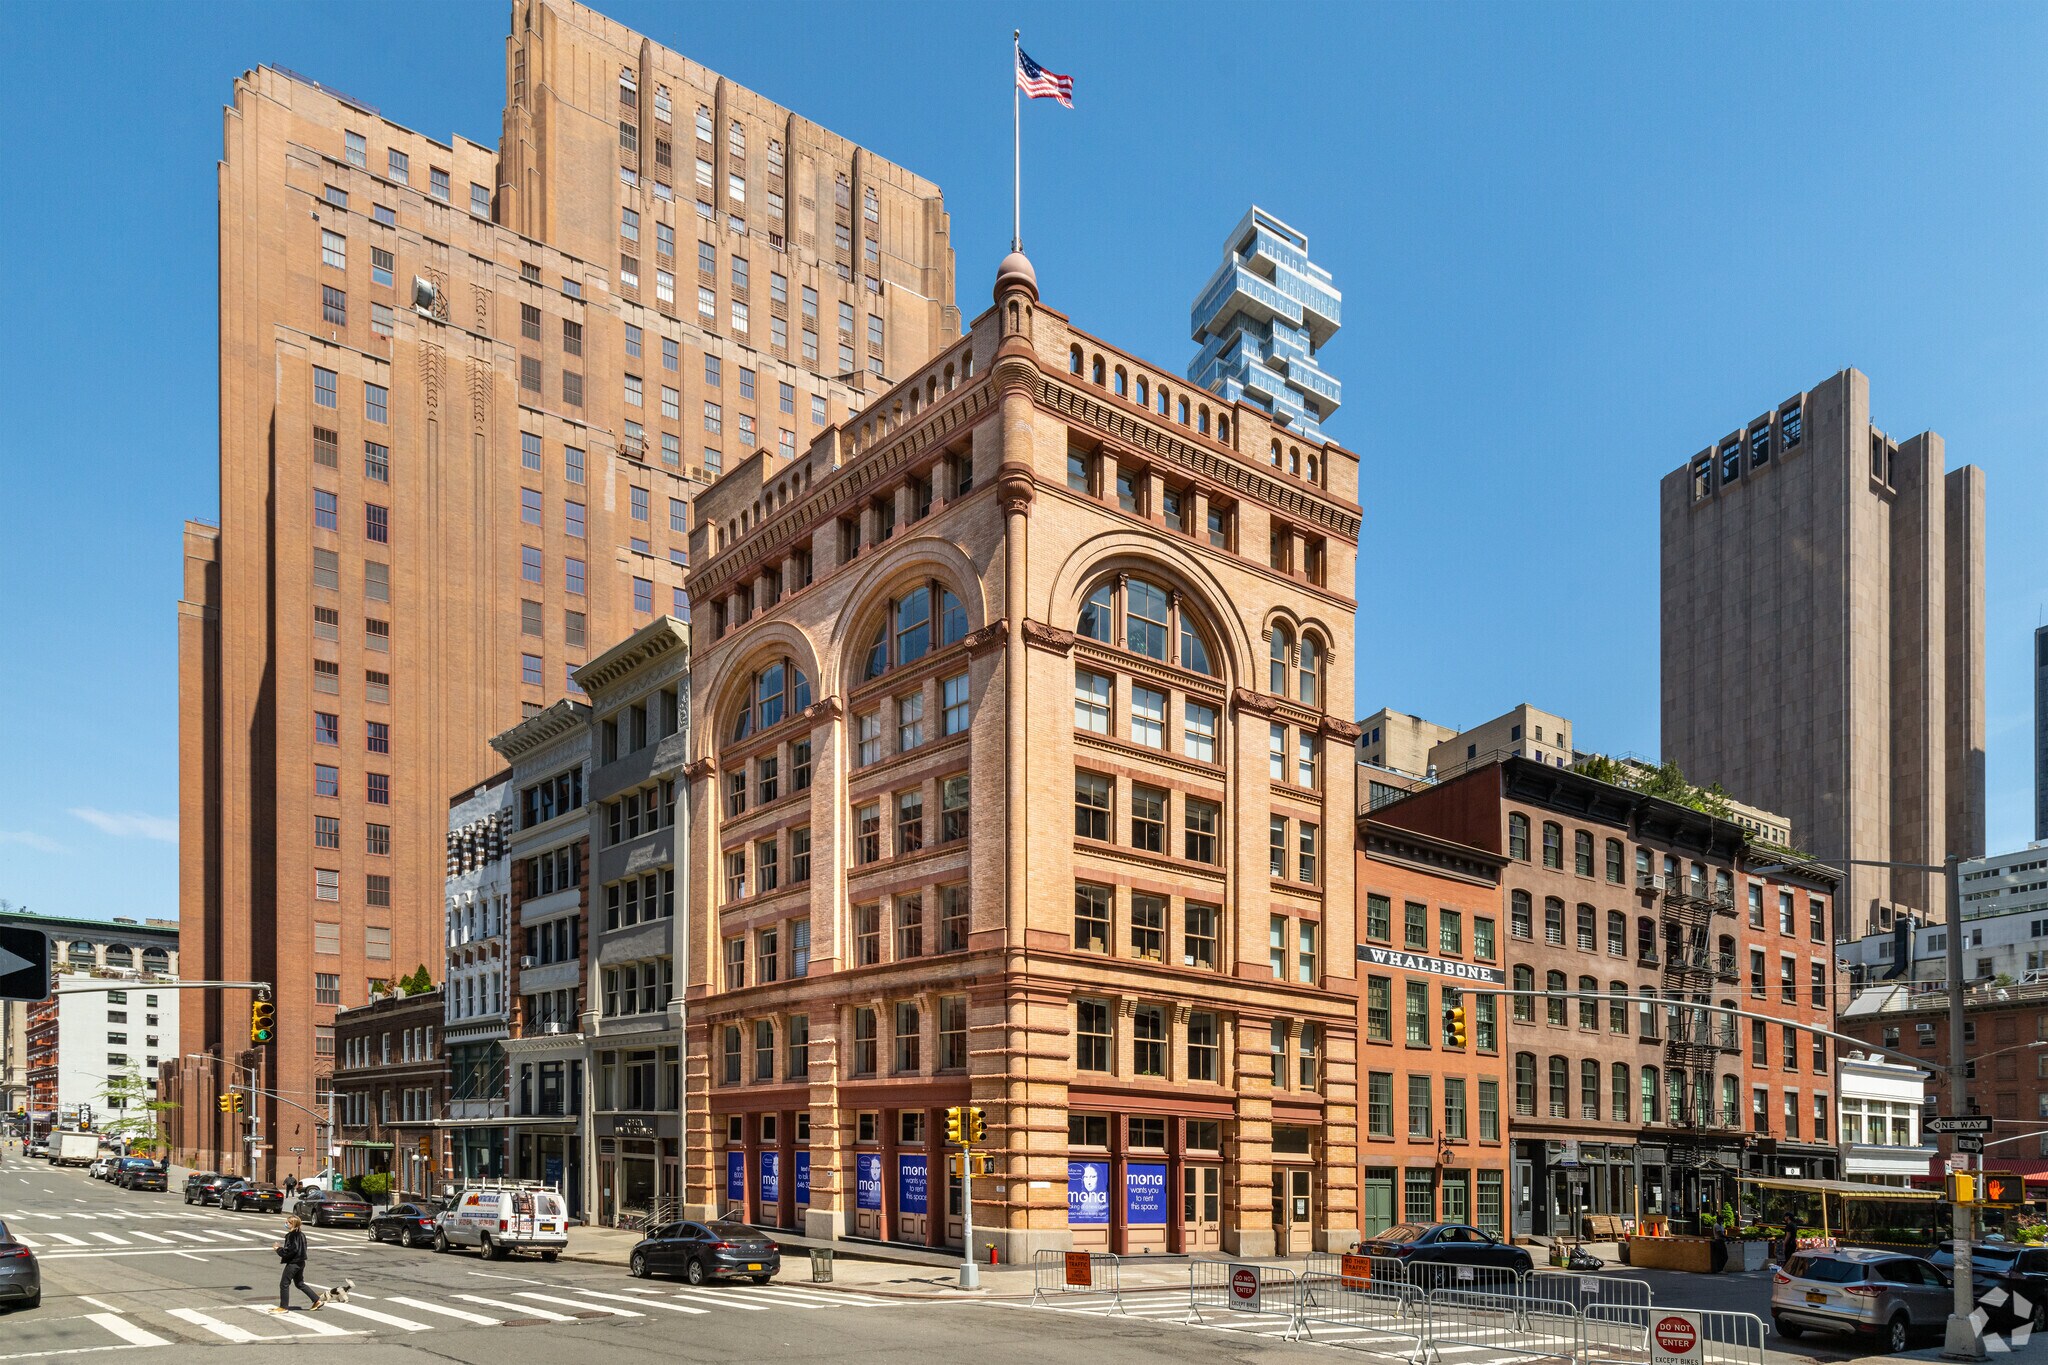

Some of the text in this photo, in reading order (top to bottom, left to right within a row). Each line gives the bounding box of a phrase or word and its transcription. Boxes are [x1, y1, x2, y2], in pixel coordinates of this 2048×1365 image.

[1934, 1121, 1955, 1129] ONE
[1127, 1174, 1163, 1186] mona
[1147, 1188, 1159, 1196] you
[1068, 1191, 1107, 1203] mona
[1130, 1202, 1159, 1212] this space
[1354, 1258, 1368, 1266] THRU
[1345, 1264, 1367, 1272] TRAFFIC
[1236, 1286, 1253, 1294] ENTER
[1674, 1324, 1691, 1332] NOT
[1662, 1338, 1690, 1347] ENTER
[1655, 1356, 1678, 1364] EXCEPT
